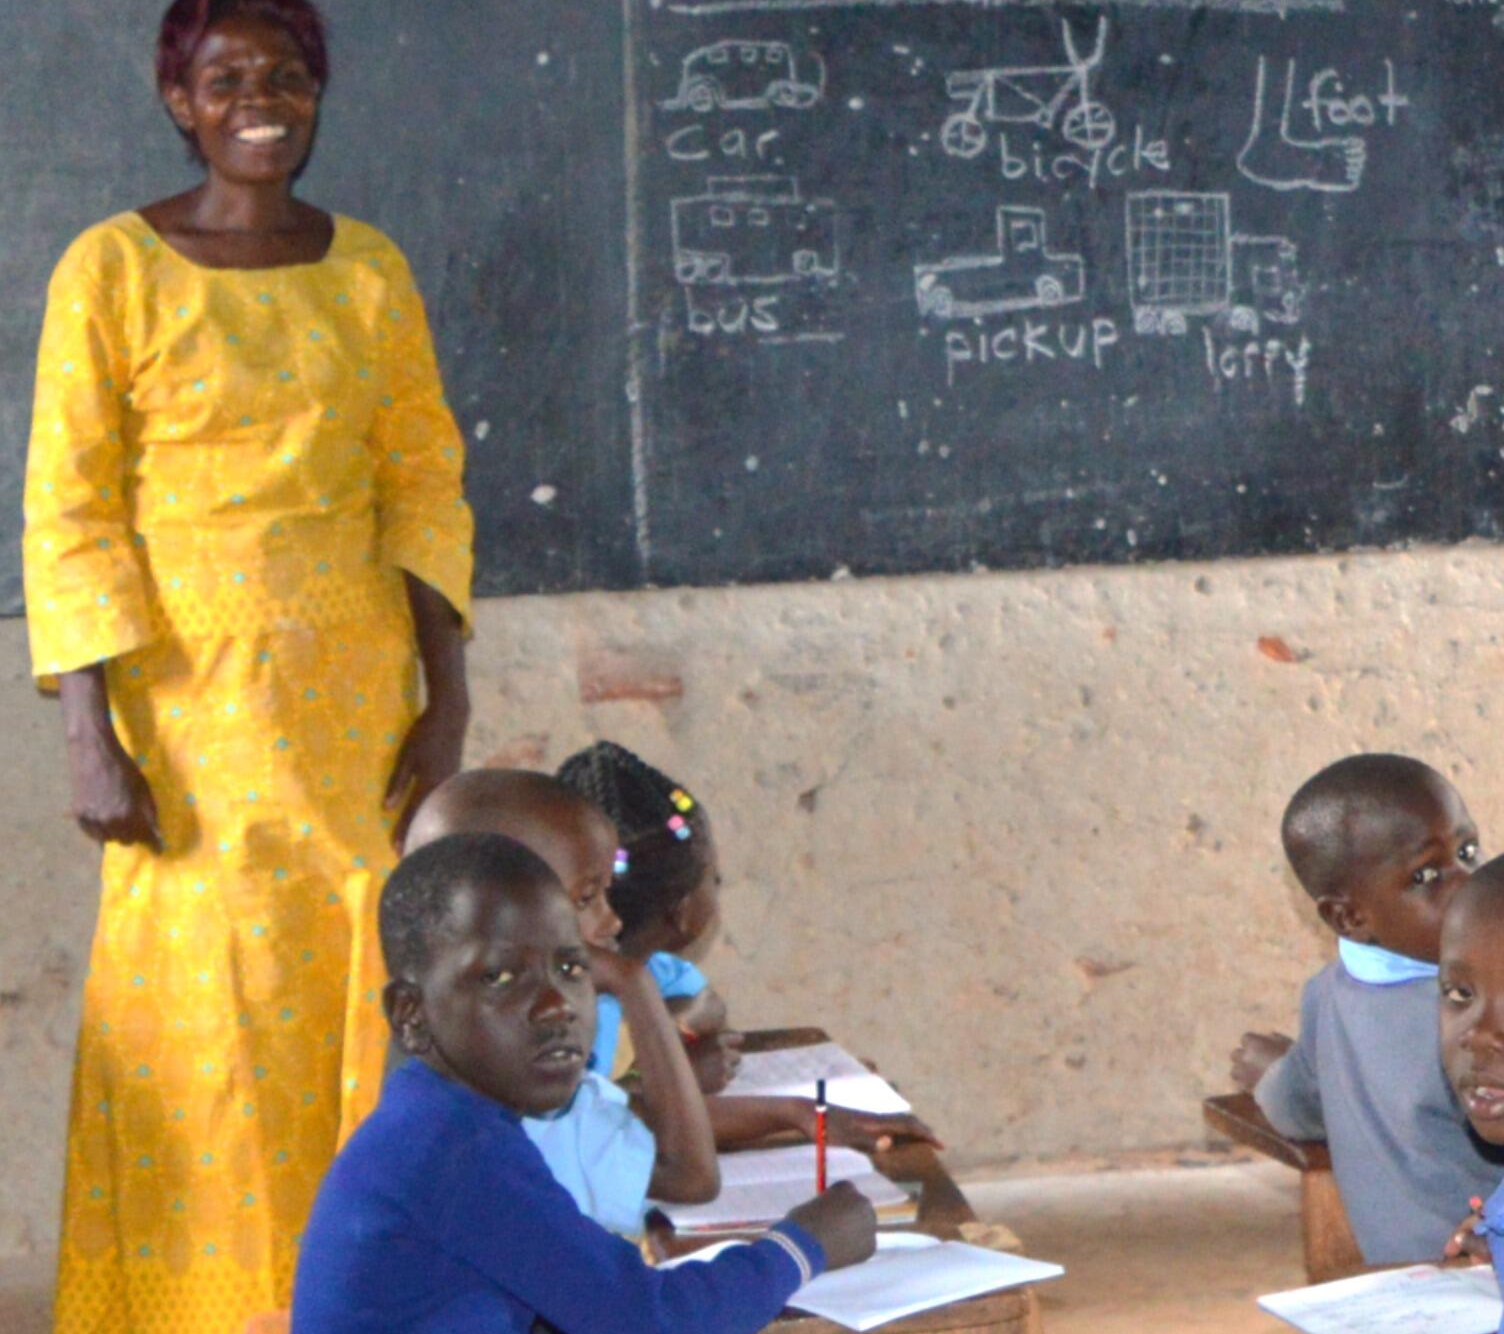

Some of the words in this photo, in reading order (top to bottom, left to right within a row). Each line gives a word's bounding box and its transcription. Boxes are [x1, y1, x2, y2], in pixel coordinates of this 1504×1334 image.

[1302, 58, 1410, 132] foot
[999, 124, 1172, 189] bicycle
[683, 285, 781, 335] bus
